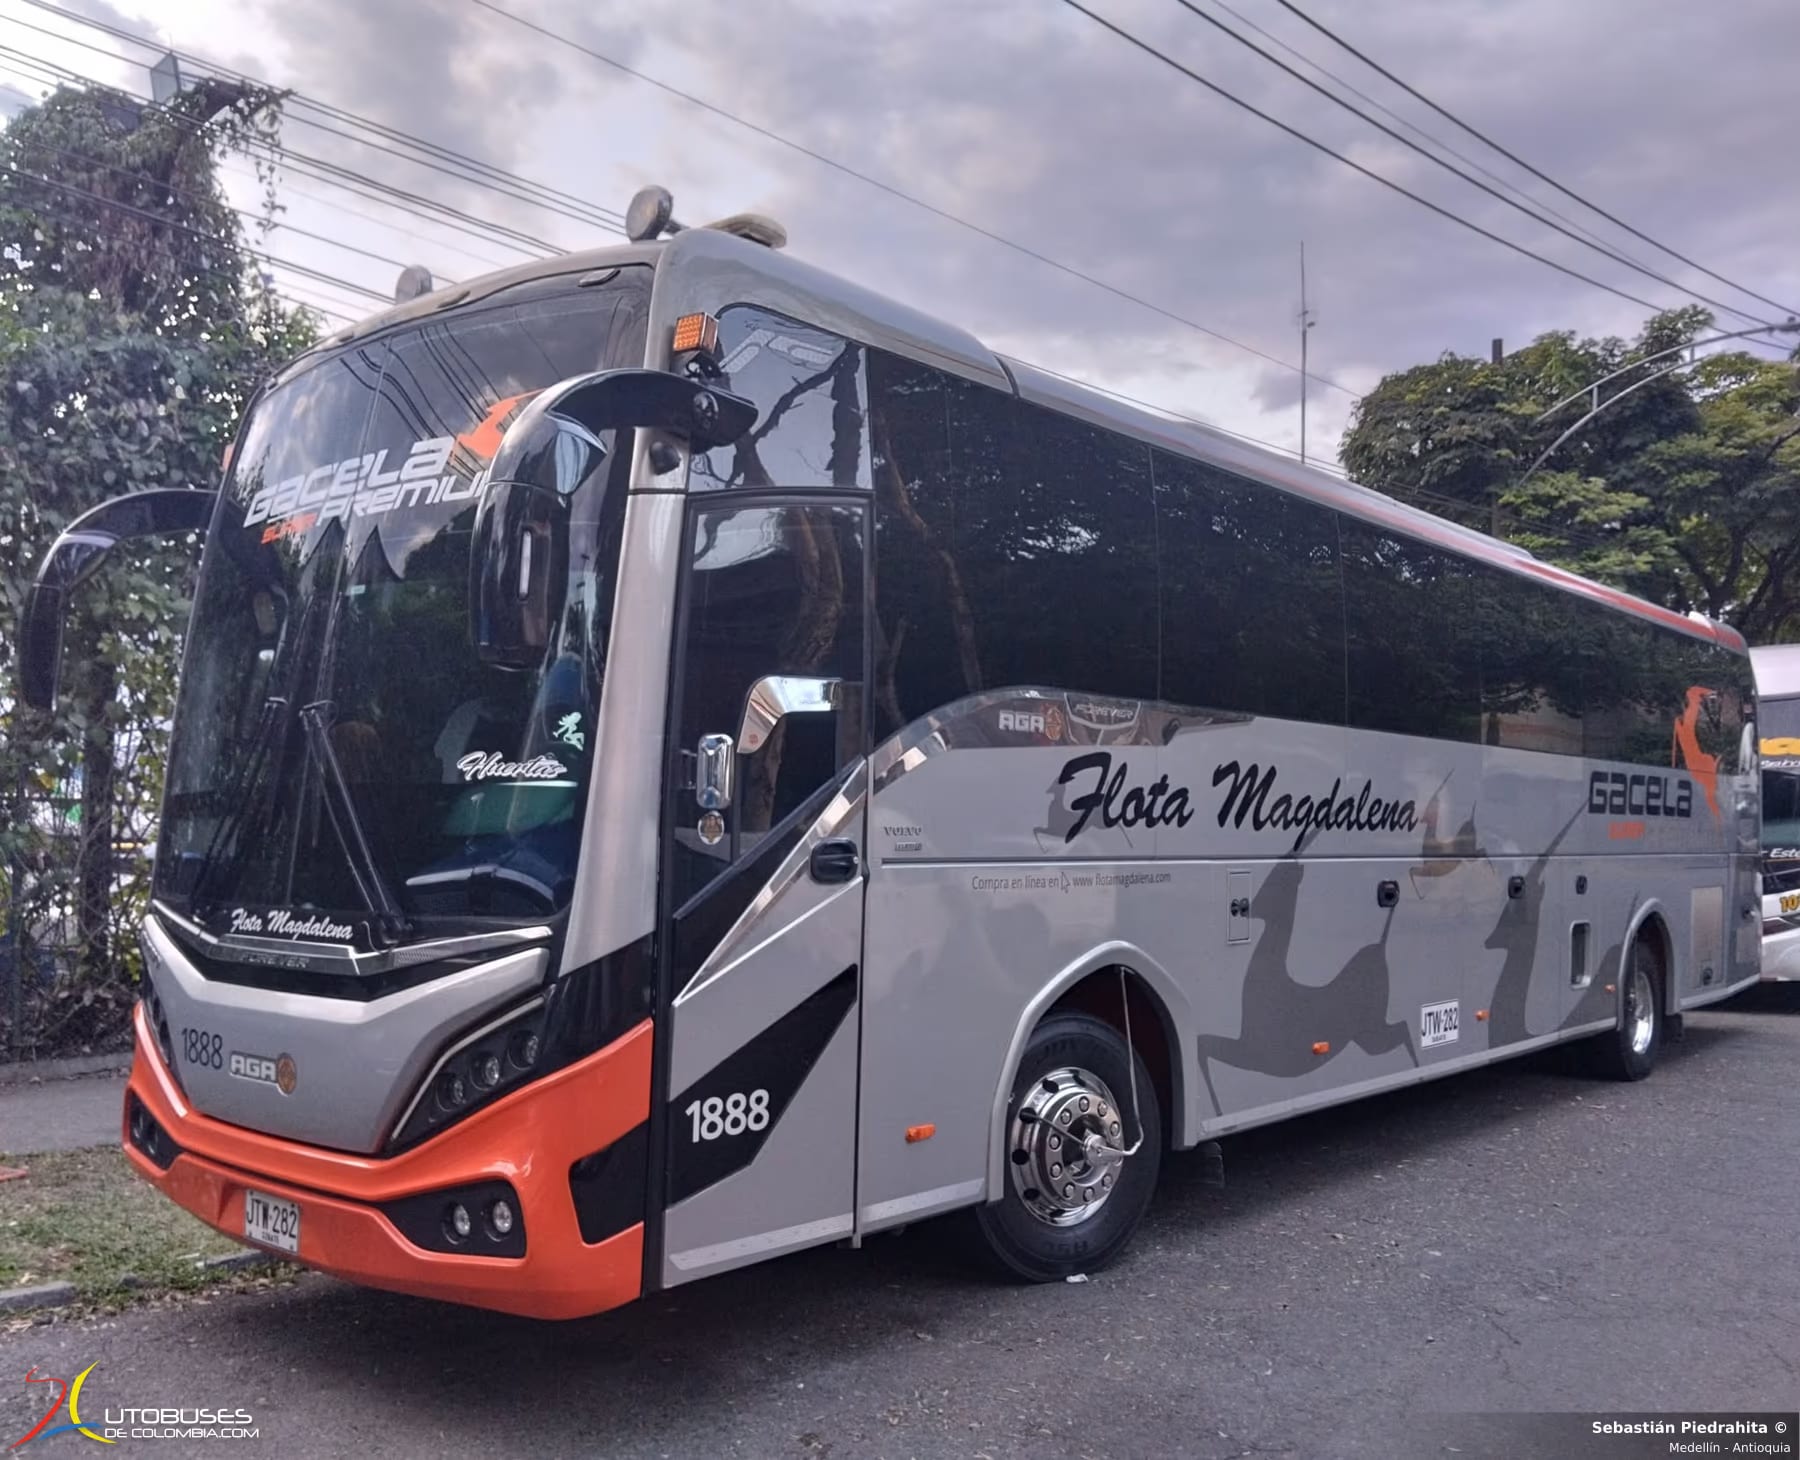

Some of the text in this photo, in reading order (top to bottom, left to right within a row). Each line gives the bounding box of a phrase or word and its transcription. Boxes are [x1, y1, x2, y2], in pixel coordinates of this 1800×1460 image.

[999, 711, 1044, 733] AGA
[1058, 751, 1419, 850] Flota Magdalena
[971, 875, 1009, 893] Compra
[1011, 877, 1023, 889] en
[1048, 876, 1060, 888] en
[1780, 894, 1800, 913] 10
[231, 907, 354, 941] Flota Magdalena
[182, 1027, 224, 1070] 1888
[231, 1053, 277, 1081] AGA
[684, 1089, 770, 1143] 1888
